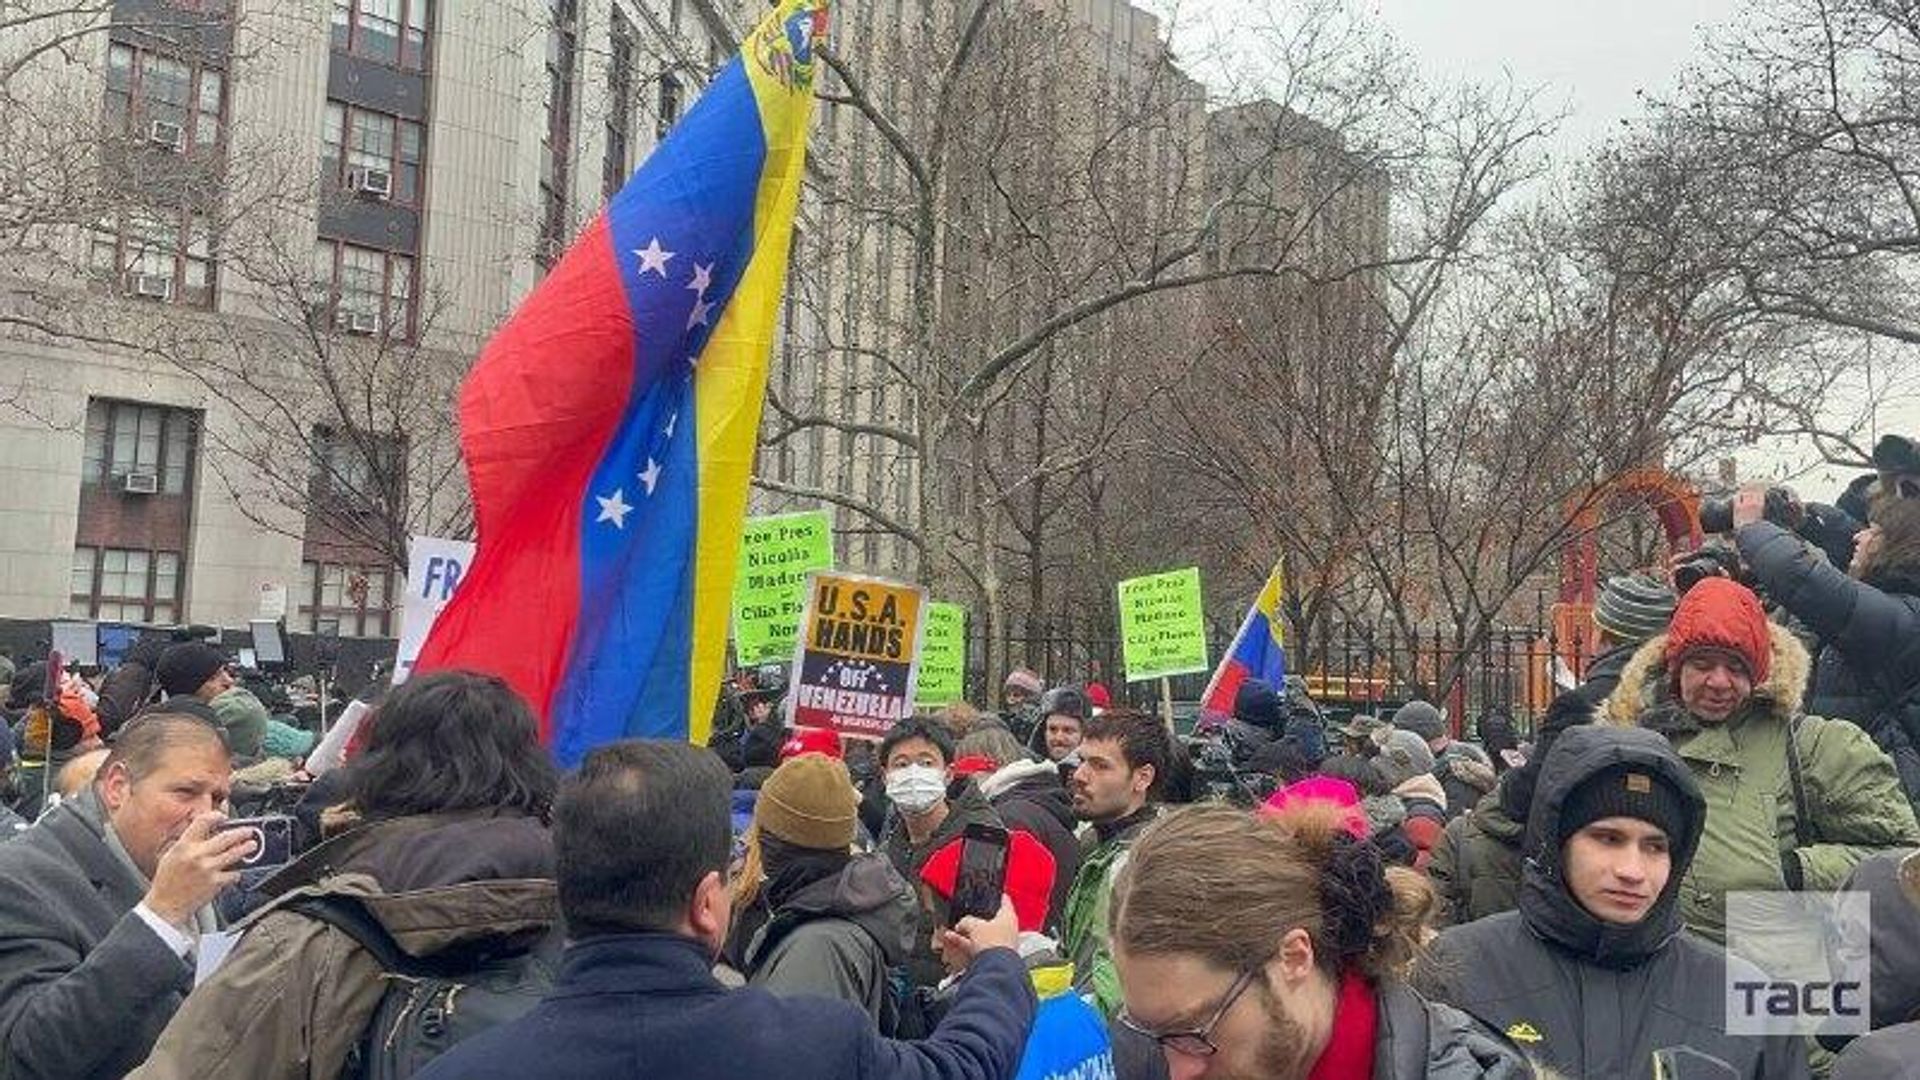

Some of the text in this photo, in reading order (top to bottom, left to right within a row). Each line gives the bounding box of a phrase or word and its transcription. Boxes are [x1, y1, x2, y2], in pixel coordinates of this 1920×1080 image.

[741, 605, 778, 620] Cilia
[818, 584, 906, 627] U.S.A.
[816, 618, 904, 659] HANDS
[839, 666, 870, 689] OFF
